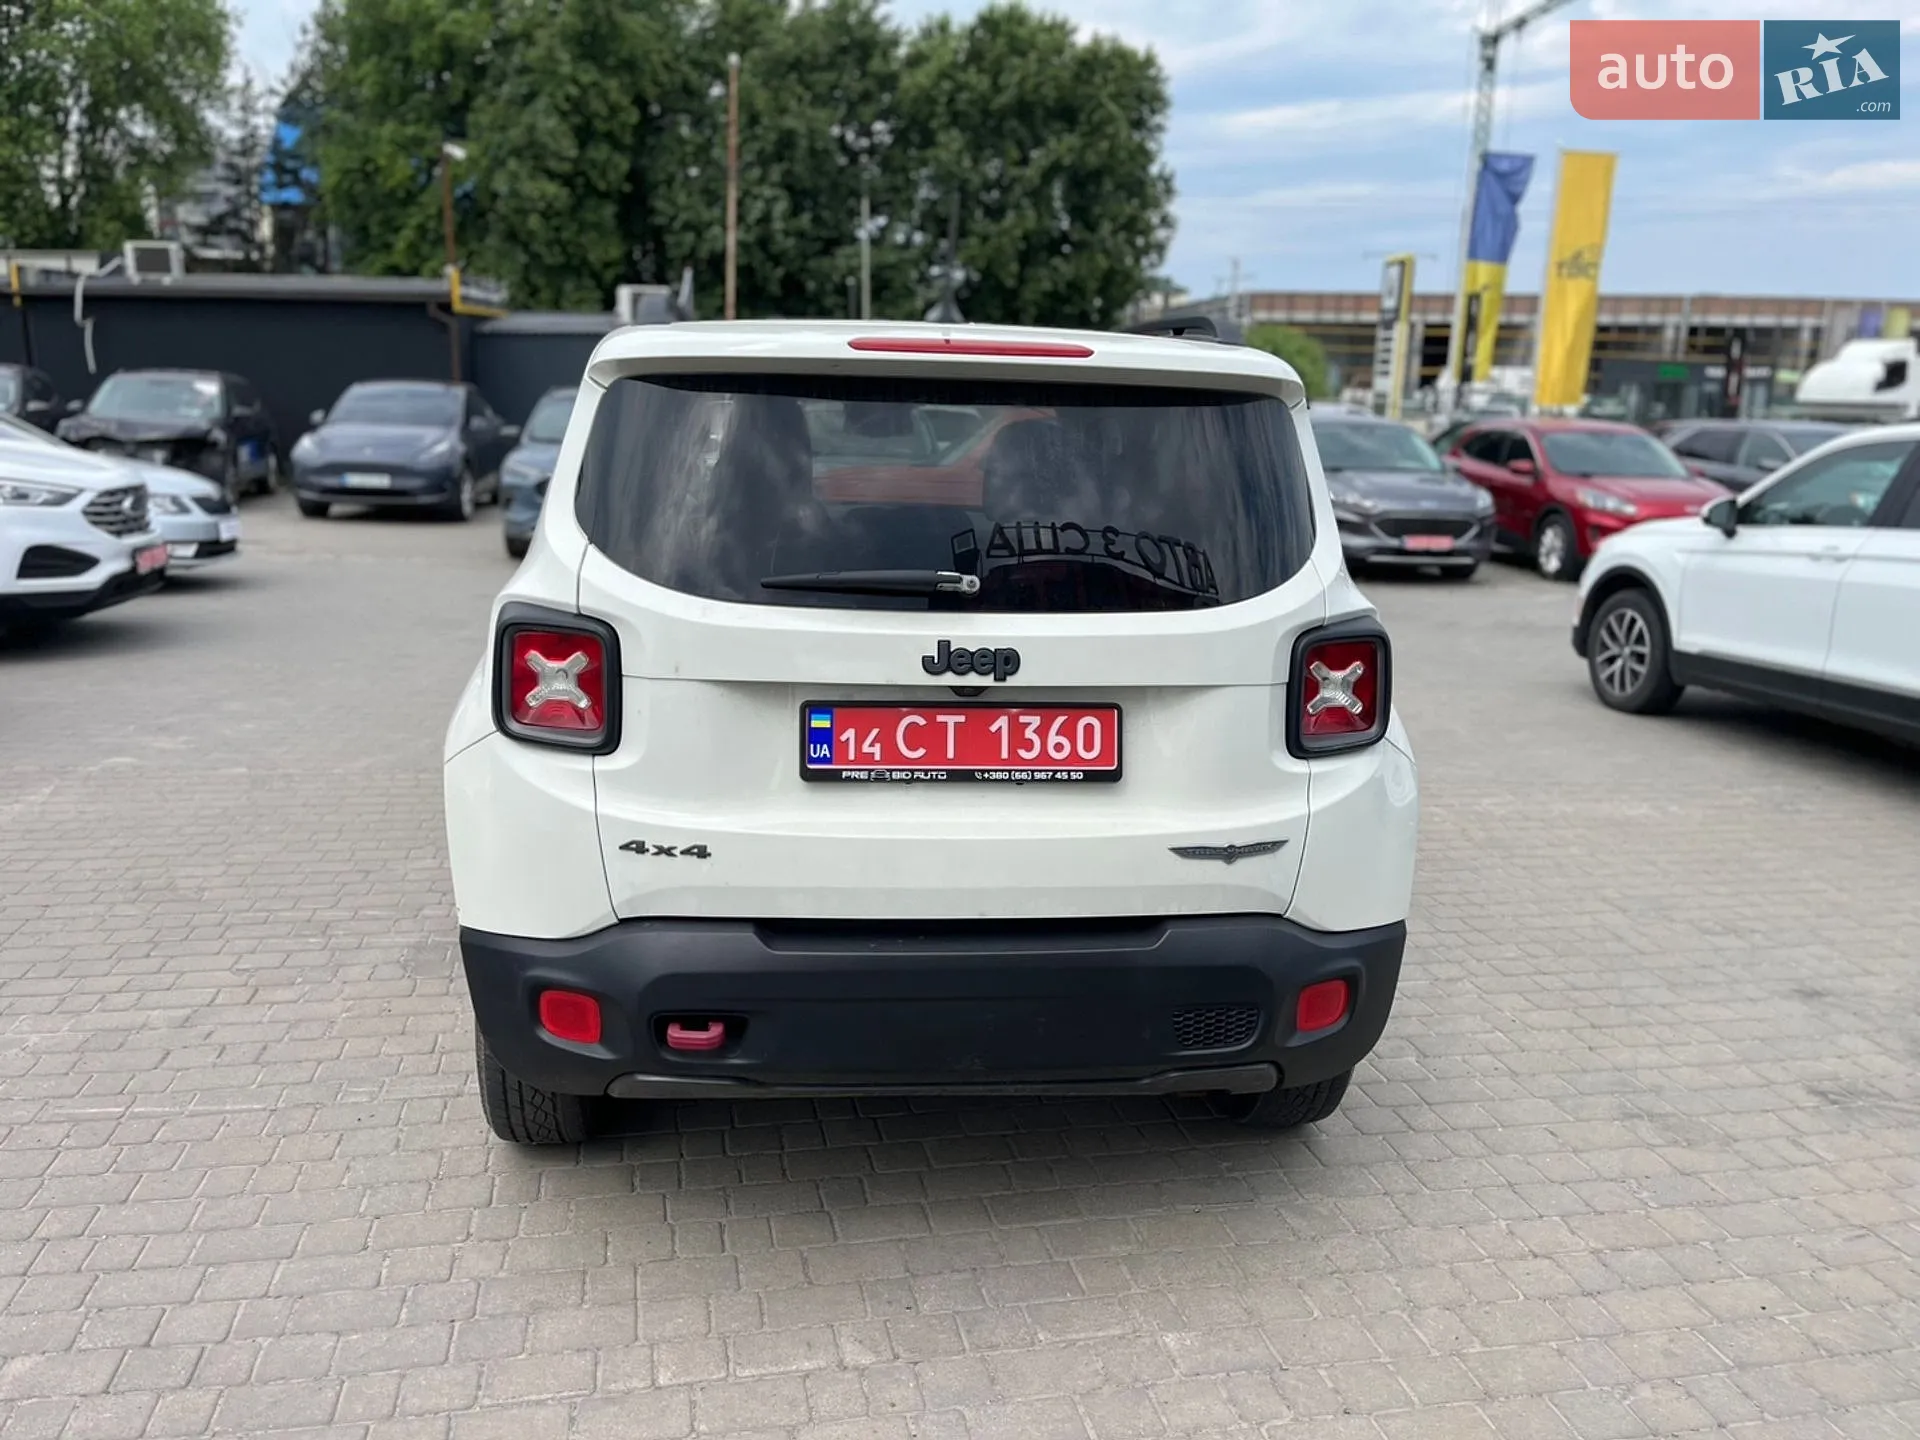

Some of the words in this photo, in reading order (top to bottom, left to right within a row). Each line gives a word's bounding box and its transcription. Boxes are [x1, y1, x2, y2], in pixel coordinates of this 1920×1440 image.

[921, 639, 1021, 682] Jeep
[839, 727, 882, 762] 14
[895, 714, 967, 760] CT
[988, 714, 1102, 761] 1360
[809, 743, 831, 759] UA
[841, 770, 869, 780] PRE
[913, 770, 948, 780] AUTO
[618, 839, 712, 860] 4x4
